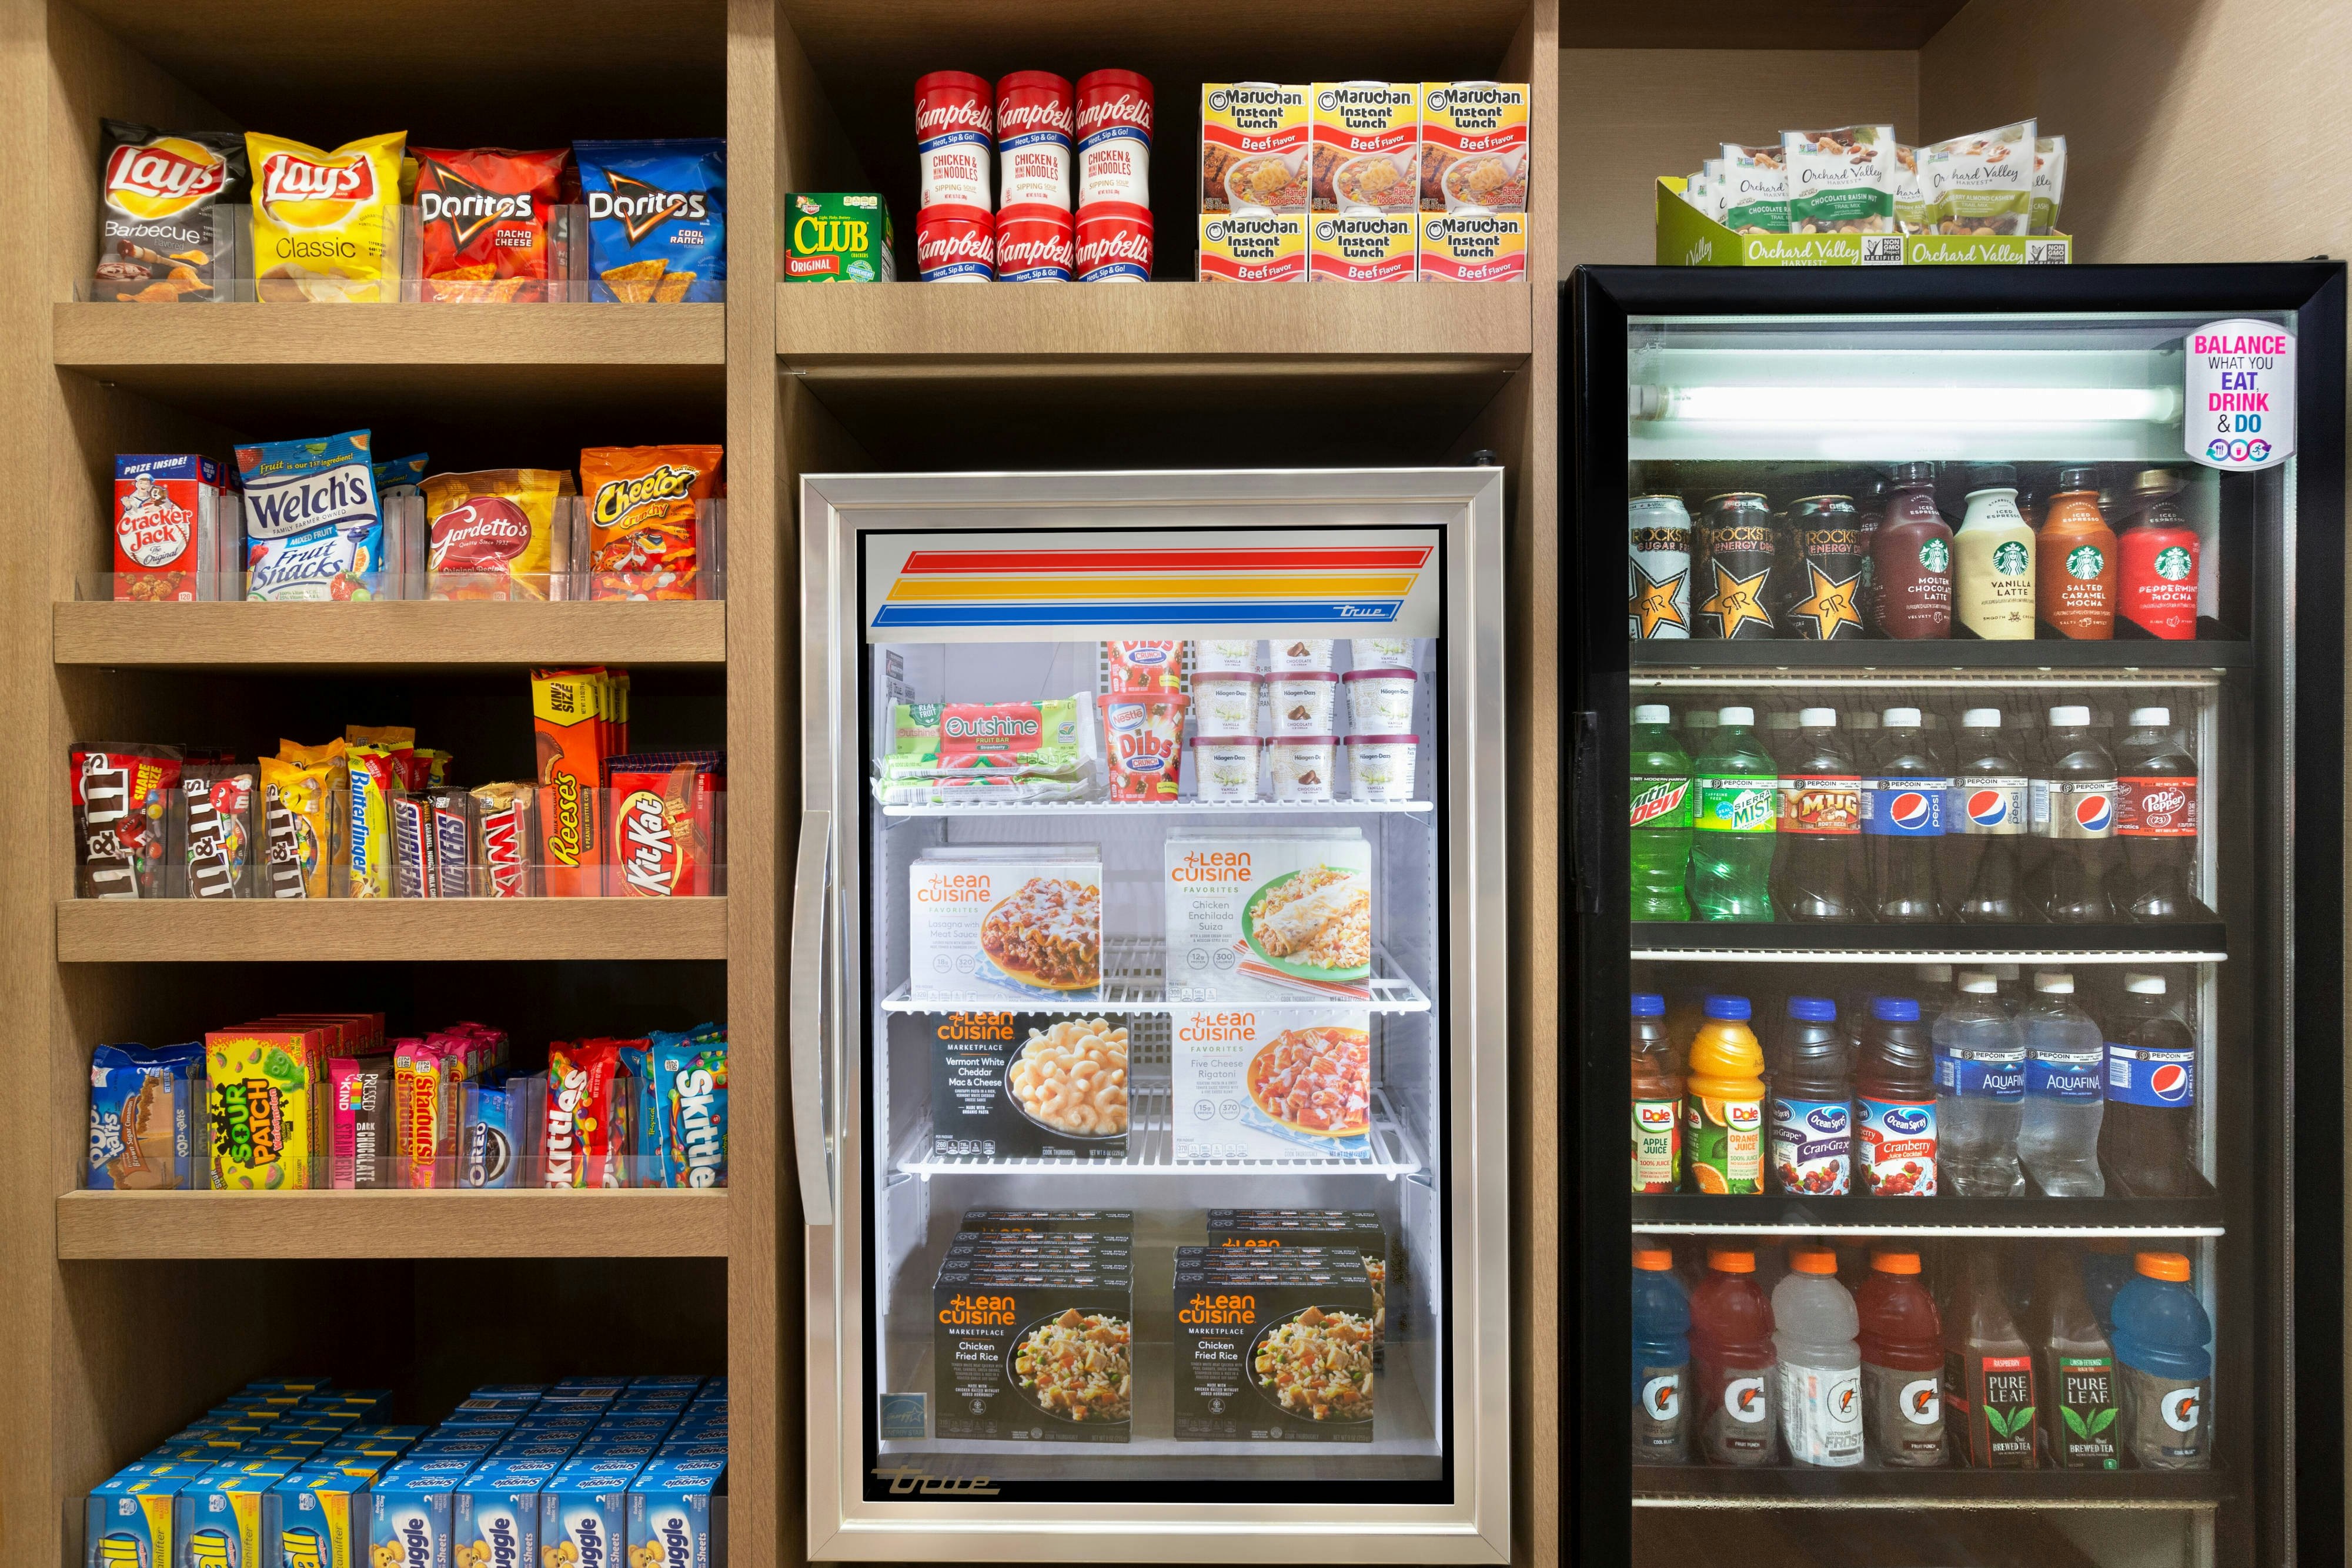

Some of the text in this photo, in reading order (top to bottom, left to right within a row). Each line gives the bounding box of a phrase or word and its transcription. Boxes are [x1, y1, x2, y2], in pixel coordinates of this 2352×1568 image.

[1225, 89, 1302, 106] Maruchan
[1231, 106, 1284, 117] Instant
[1237, 118, 1278, 128] Lunch
[932, 136, 948, 147] Heat,
[948, 134, 958, 143] Sip
[1241, 135, 1295, 150] Beef Flavor
[933, 154, 977, 168] CHICKEN &
[944, 166, 978, 182] NOODLES
[934, 183, 962, 192] SIPPING
[421, 193, 533, 221] Doritos
[589, 193, 707, 220] Doritos
[1810, 195, 1847, 206] CHOCOLATE
[105, 220, 200, 244] Barbecue
[497, 229, 532, 239] NACHO
[670, 236, 704, 245] RANCH
[677, 229, 704, 238] COOL
[794, 216, 869, 255] CLUB
[276, 236, 356, 259] Classic
[495, 238, 533, 247] CHEESE
[1748, 240, 1859, 265] Orchard Valley
[791, 259, 831, 273] ORIGINAL
[2194, 335, 2286, 355] BALANCE
[2208, 356, 2273, 370] WHAT YOU
[2221, 372, 2260, 392] EAT,
[2209, 393, 2269, 412] DRINK
[2217, 414, 2261, 433] & DO
[124, 456, 188, 476] PRIZE INSIDE!
[259, 460, 284, 475] Fruit
[321, 453, 353, 467] Ingredient!
[248, 472, 368, 529] Welch's
[593, 465, 697, 526] Cheetos
[117, 507, 194, 536] Cracker
[272, 509, 347, 535] FAMILY FARMER OWNED
[620, 503, 668, 529] Crunchy
[130, 525, 175, 553] Jack
[289, 527, 333, 546] MIXED FRUIT
[431, 506, 528, 570] Gardetto's
[459, 537, 477, 548] Quality
[150, 546, 162, 554] The
[275, 540, 337, 569] Fruit
[1715, 541, 1756, 552] ENERGY
[143, 547, 178, 566] Original
[253, 556, 343, 591] Snacks
[1991, 580, 2031, 589] VANILLA
[945, 716, 1040, 736] Outshine
[1119, 730, 1174, 760] Dibs
[1132, 758, 1159, 768] CRUNCH
[133, 763, 151, 801] SHARE
[148, 765, 162, 791] SIZE
[1734, 789, 1770, 811] SIERRA
[1801, 794, 1858, 817] MUG
[2147, 794, 2184, 813] Pepper
[2158, 791, 2175, 801] Dr
[548, 771, 580, 867] Reese's
[1734, 796, 1772, 827] MIST
[1931, 794, 1940, 827] pepsi
[350, 769, 370, 876] Butterfinger
[1200, 852, 1251, 866] Lean
[1192, 900, 1230, 909] Chicken
[1188, 911, 1234, 920] Enchilada
[1198, 922, 1223, 931] Suiza
[946, 1057, 1005, 1066] Vermont White
[1191, 1059, 1244, 1068] Five Cheese
[958, 1068, 993, 1076] Cheddar
[1198, 1069, 1237, 1080] Rigatoni
[948, 1078, 966, 1086] Mac
[974, 1078, 1003, 1086] Cheese
[2046, 1074, 2101, 1091] AQUAFINA
[339, 1082, 352, 1111] KIND
[362, 1074, 379, 1111] PRESSED
[125, 1101, 133, 1126] Cinnamon
[246, 1078, 277, 1166] PATCH
[272, 1088, 285, 1151] Watermelon
[414, 1075, 437, 1166] Starburst
[225, 1085, 252, 1164] SOUR
[356, 1122, 375, 1131] DARK
[676, 1069, 722, 1188] Skittle
[1887, 1116, 1926, 1132] Ocean Spray
[1643, 1138, 1668, 1146] APPLE
[1729, 1134, 1759, 1143] ORANGE
[1883, 1139, 1930, 1154] Cranberry
[129, 1146, 141, 1167] Brown
[335, 1123, 353, 1182] STRAWBERRY
[356, 1132, 376, 1182] CHOCOLATE
[470, 1122, 487, 1187] OREO
[1644, 1146, 1667, 1154] JUICE
[958, 1342, 995, 1351] Chicken
[956, 1352, 999, 1362] Fried Rice
[1989, 1376, 2027, 1389] PURE
[1724, 1376, 1765, 1423] G
[1990, 1389, 2026, 1403] LEAF
[1992, 1442, 2031, 1452] BREWED TEA
[437, 1533, 447, 1564] Sheets
